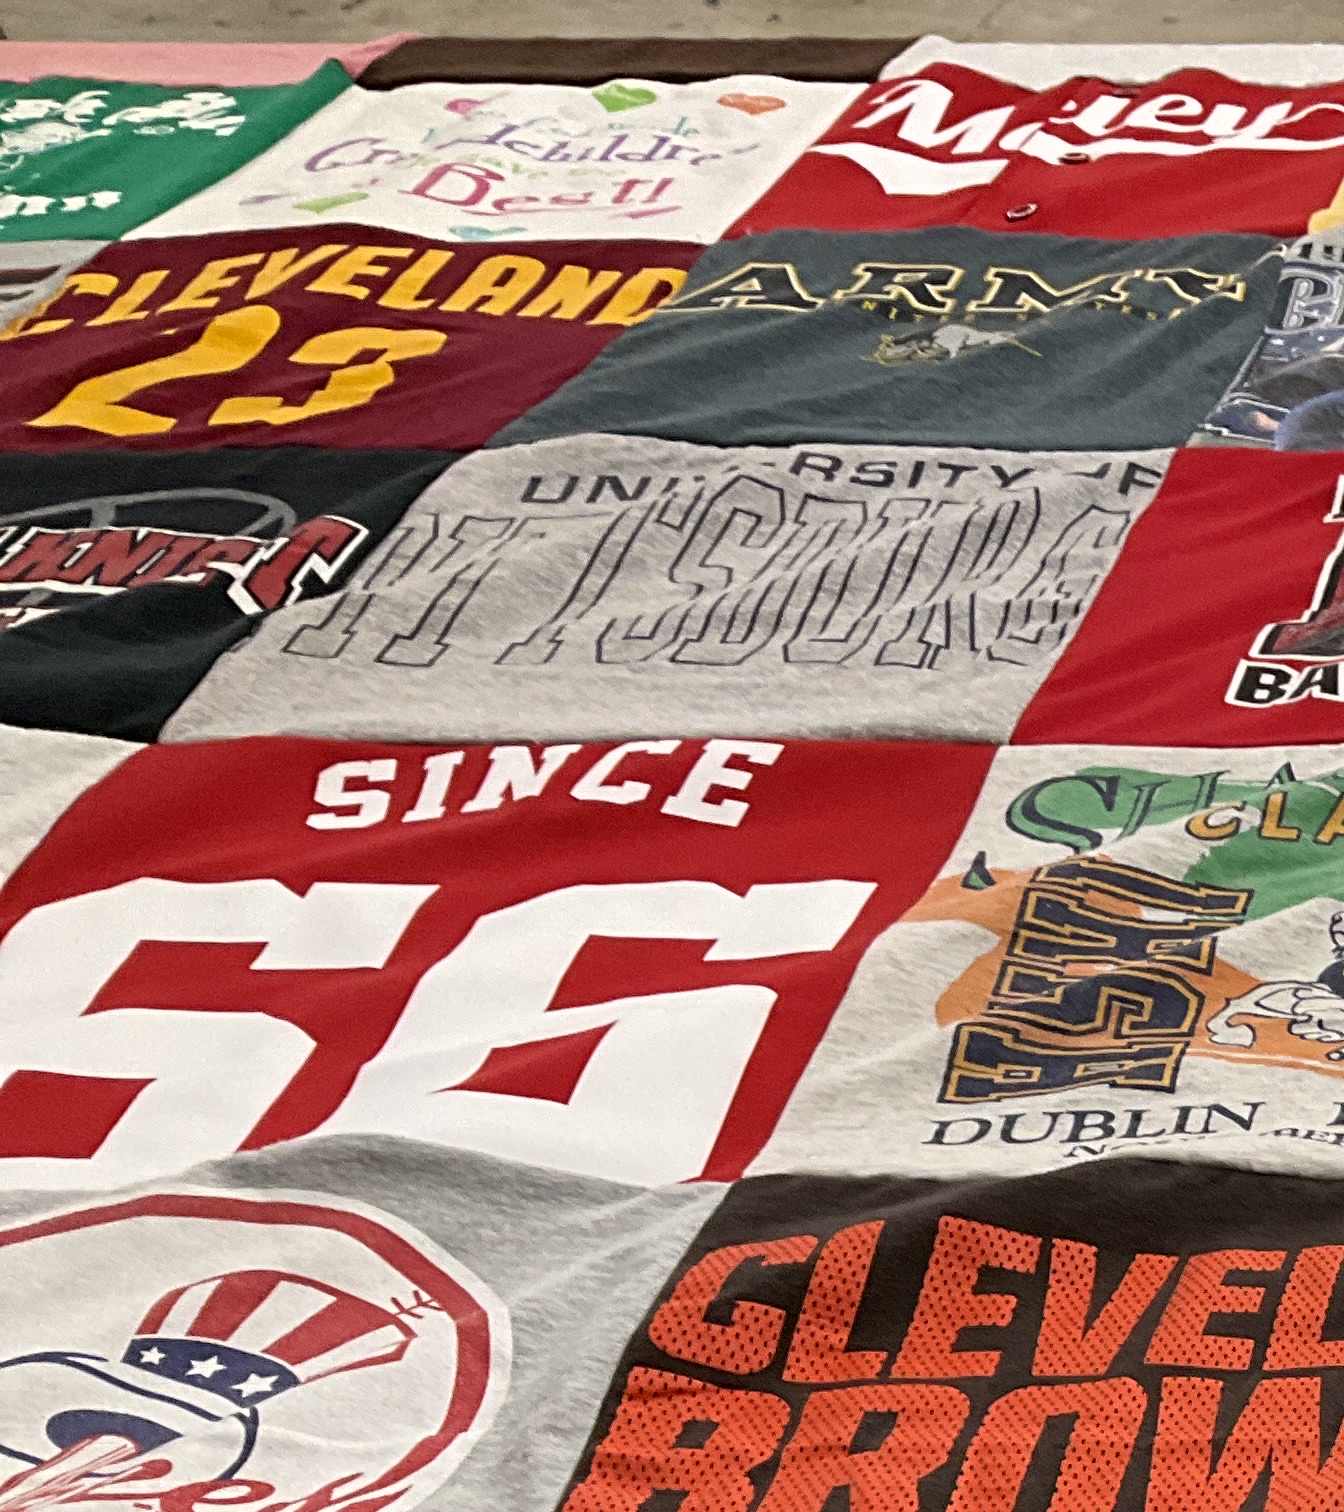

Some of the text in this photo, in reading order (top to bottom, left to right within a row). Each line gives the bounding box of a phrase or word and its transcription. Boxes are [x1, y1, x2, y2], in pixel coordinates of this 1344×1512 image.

[2, 244, 689, 340] CLEVELAND
[664, 261, 1247, 313] ARMY
[24, 303, 448, 438] 23
[304, 738, 786, 831] SINCE
[921, 1100, 1270, 1147] DUBLIN
